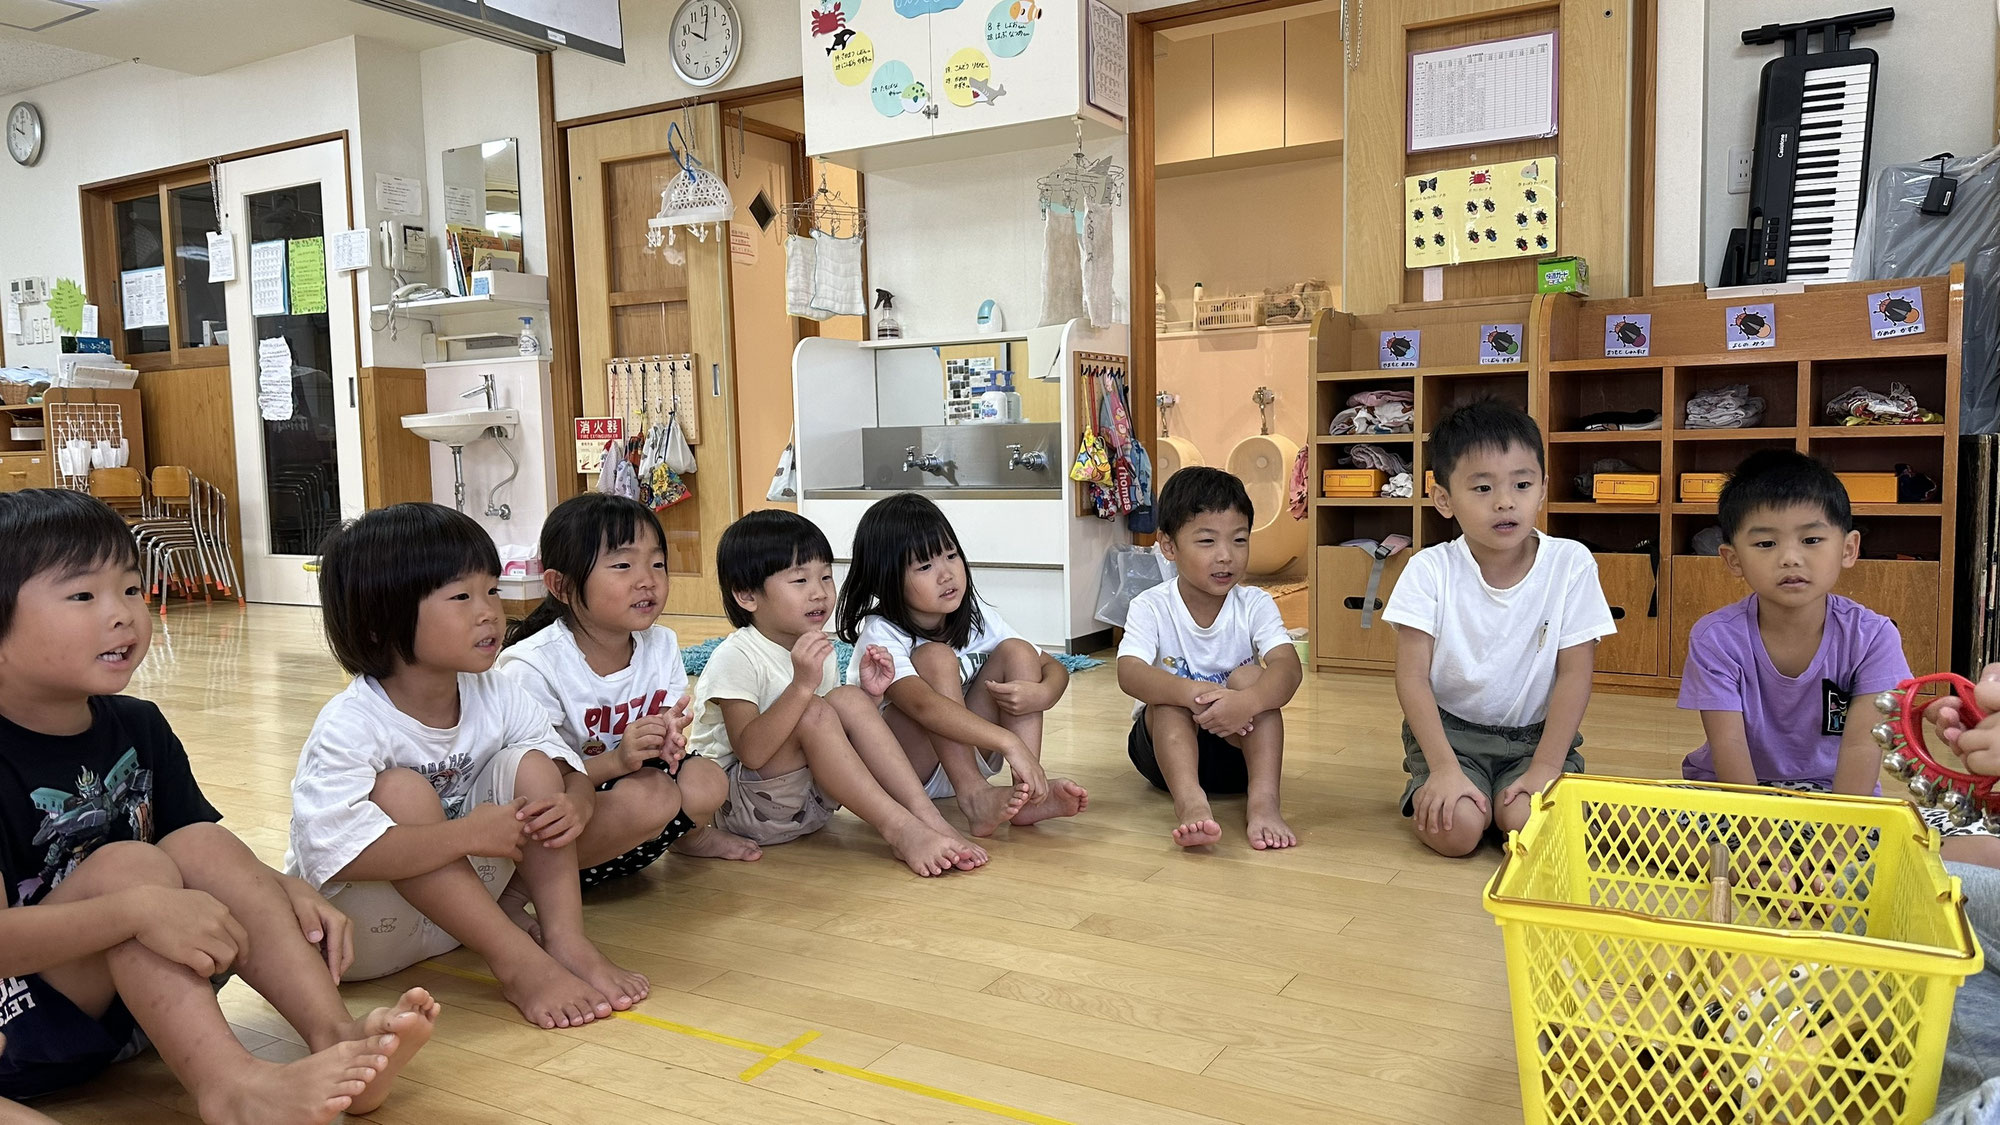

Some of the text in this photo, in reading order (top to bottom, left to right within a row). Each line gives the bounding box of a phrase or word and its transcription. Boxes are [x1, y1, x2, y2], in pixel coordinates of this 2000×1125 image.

[713, 6, 717, 17] 1
[690, 12, 697, 23] 11
[721, 14, 727, 26] 2
[682, 24, 690, 36] 10
[987, 22, 992, 31] 8
[725, 29, 731, 40] 3
[681, 39, 687, 51] 9
[722, 45, 728, 55] 4
[685, 53, 691, 64] 8
[715, 57, 721, 68] 5
[693, 62, 699, 73] 7
[704, 62, 710, 74] 6
[580, 420, 618, 434] 消火器
